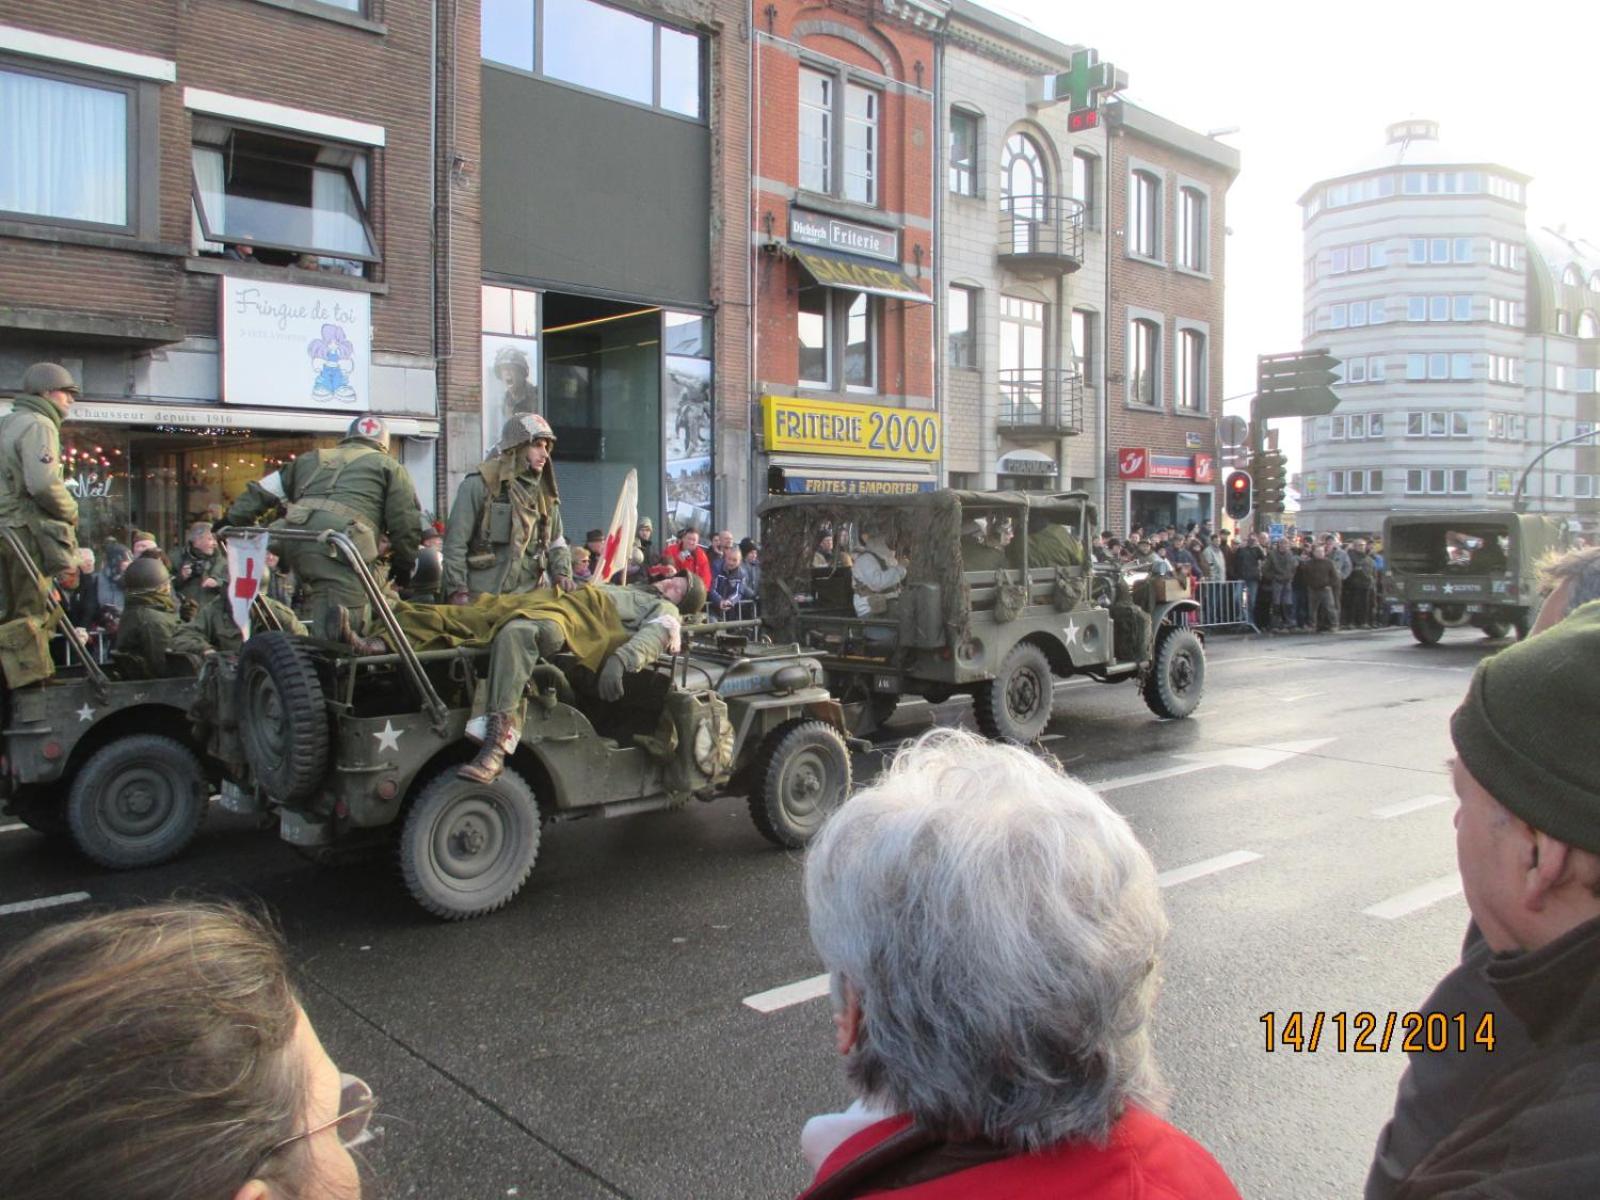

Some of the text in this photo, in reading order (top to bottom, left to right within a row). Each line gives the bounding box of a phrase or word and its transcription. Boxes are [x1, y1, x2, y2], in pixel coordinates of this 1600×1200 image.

[833, 225, 880, 251] Friterie
[804, 256, 912, 291] SNACK
[236, 288, 355, 331] Fringue de toi
[74, 407, 145, 420] Chausseur
[155, 411, 197, 423] depuis
[776, 409, 938, 454] FRITERIE 2000
[806, 479, 847, 493] FRITES
[859, 481, 920, 495] EMPORTER
